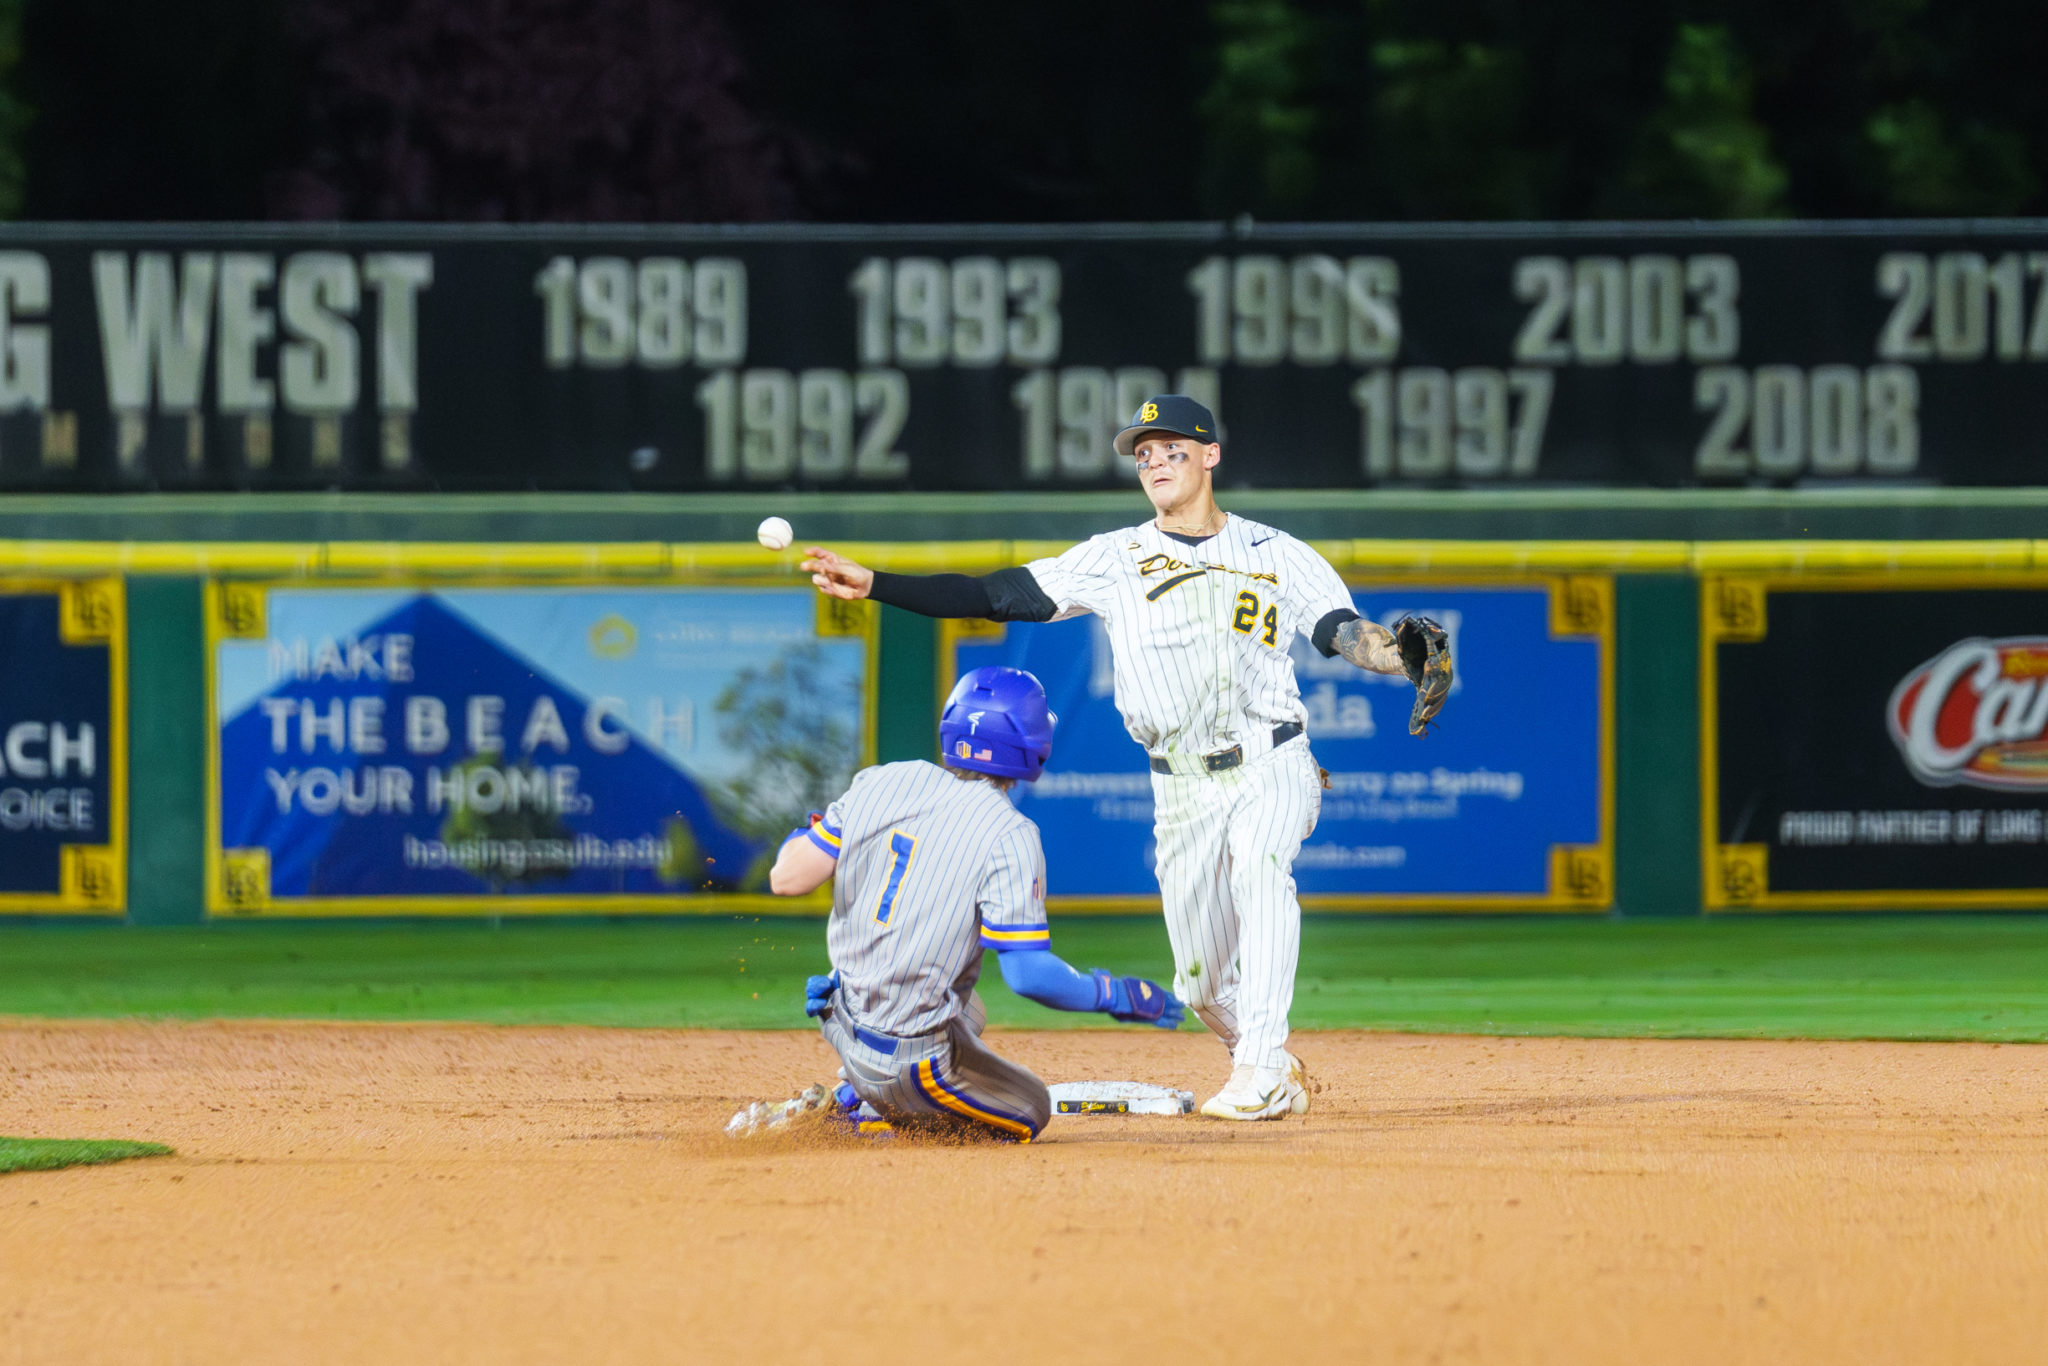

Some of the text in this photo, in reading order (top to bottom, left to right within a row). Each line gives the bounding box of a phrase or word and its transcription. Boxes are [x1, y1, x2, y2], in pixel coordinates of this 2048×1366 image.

[92, 251, 434, 412] WEST
[536, 256, 748, 367] 1989
[848, 256, 1062, 367] 1993
[1513, 254, 1740, 364] 2003
[696, 368, 911, 478] 1992
[1351, 367, 1555, 476] 1997
[1695, 366, 1920, 475] 2008
[268, 633, 415, 681] MAKE
[1232, 590, 1279, 648] 24
[0, 720, 96, 778] CH
[261, 695, 695, 754] THE BEACH
[265, 766, 414, 815] YOUR
[873, 828, 918, 927] 1
